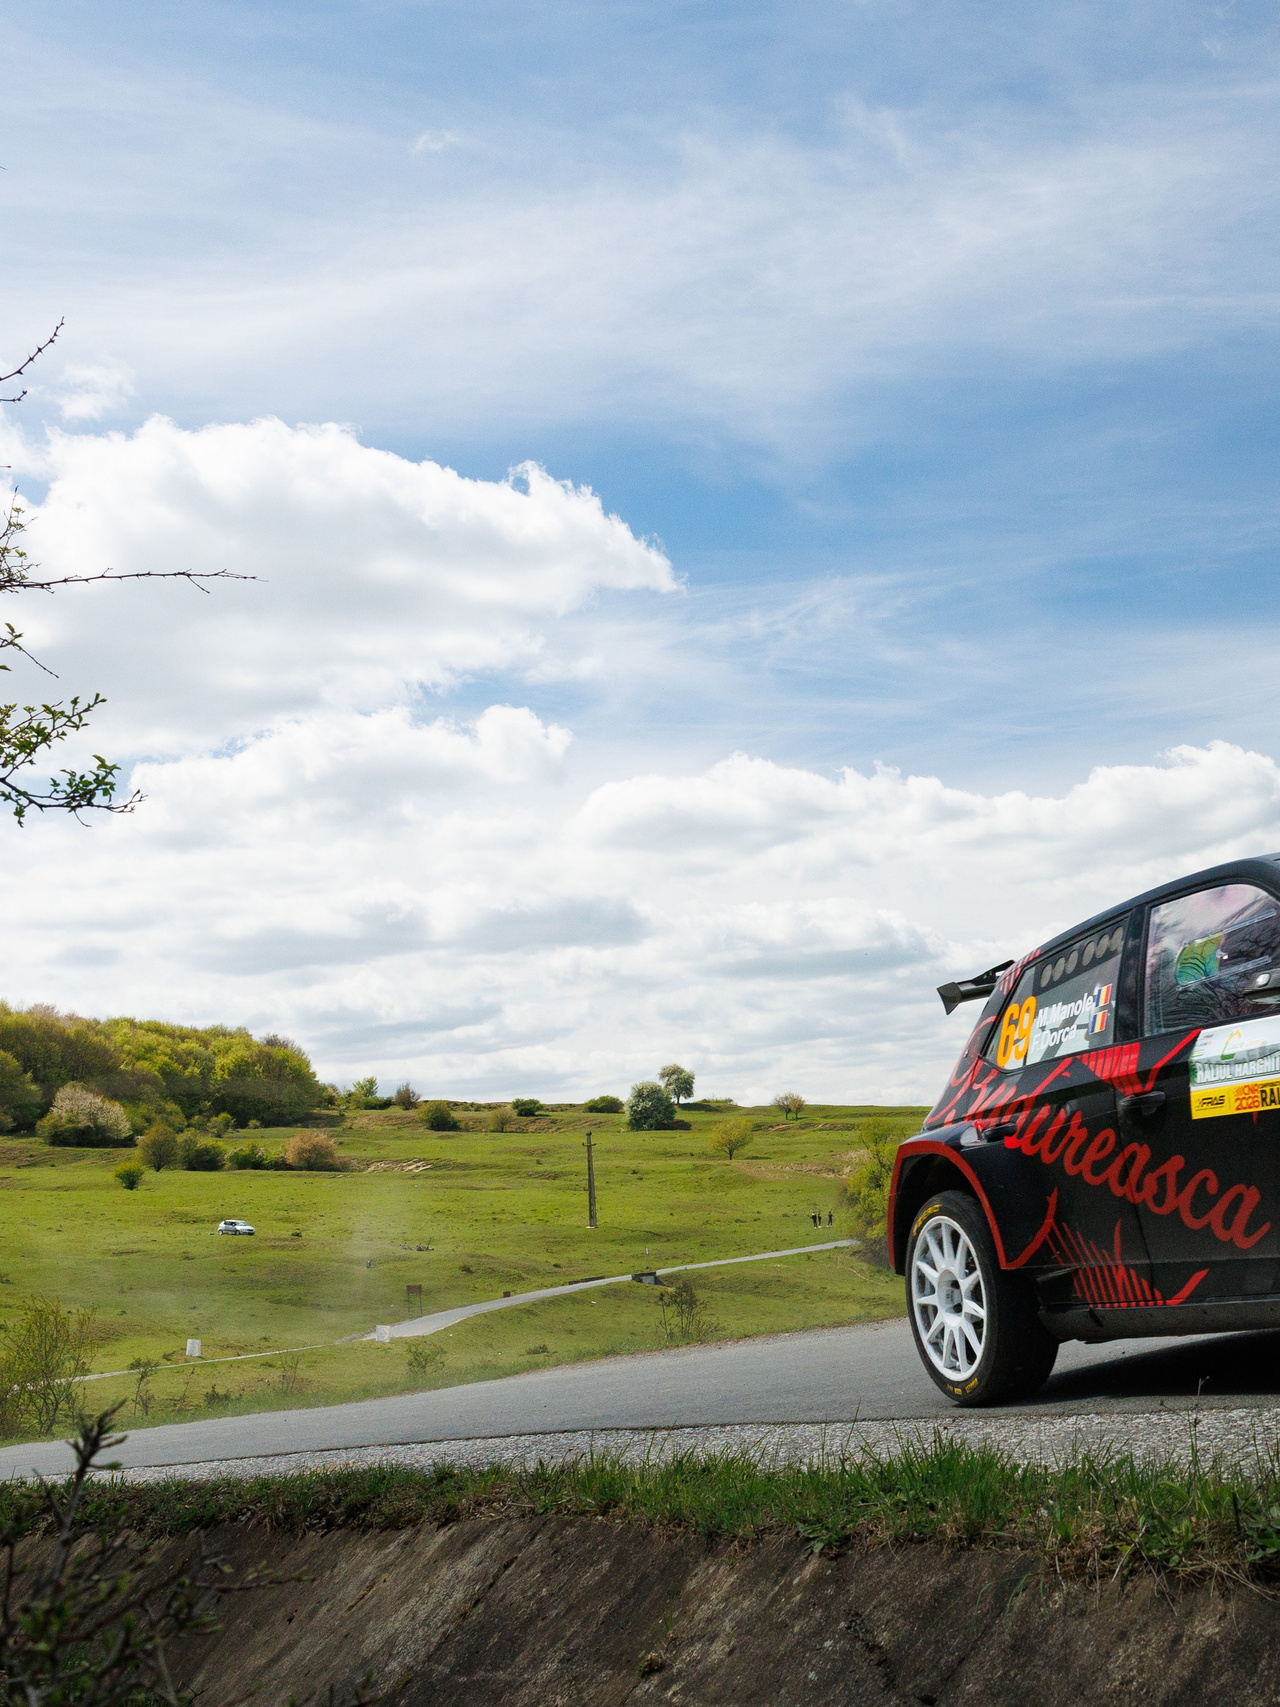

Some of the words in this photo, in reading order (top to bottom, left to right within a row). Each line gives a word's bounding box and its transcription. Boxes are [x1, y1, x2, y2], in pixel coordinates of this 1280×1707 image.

[1037, 993, 1094, 1028] M.Manole
[997, 996, 1037, 1068] 69
[1031, 1024, 1077, 1054] F.Dorca
[1196, 1061, 1233, 1084] RALIUL
[1235, 1096, 1261, 1111] 2026
